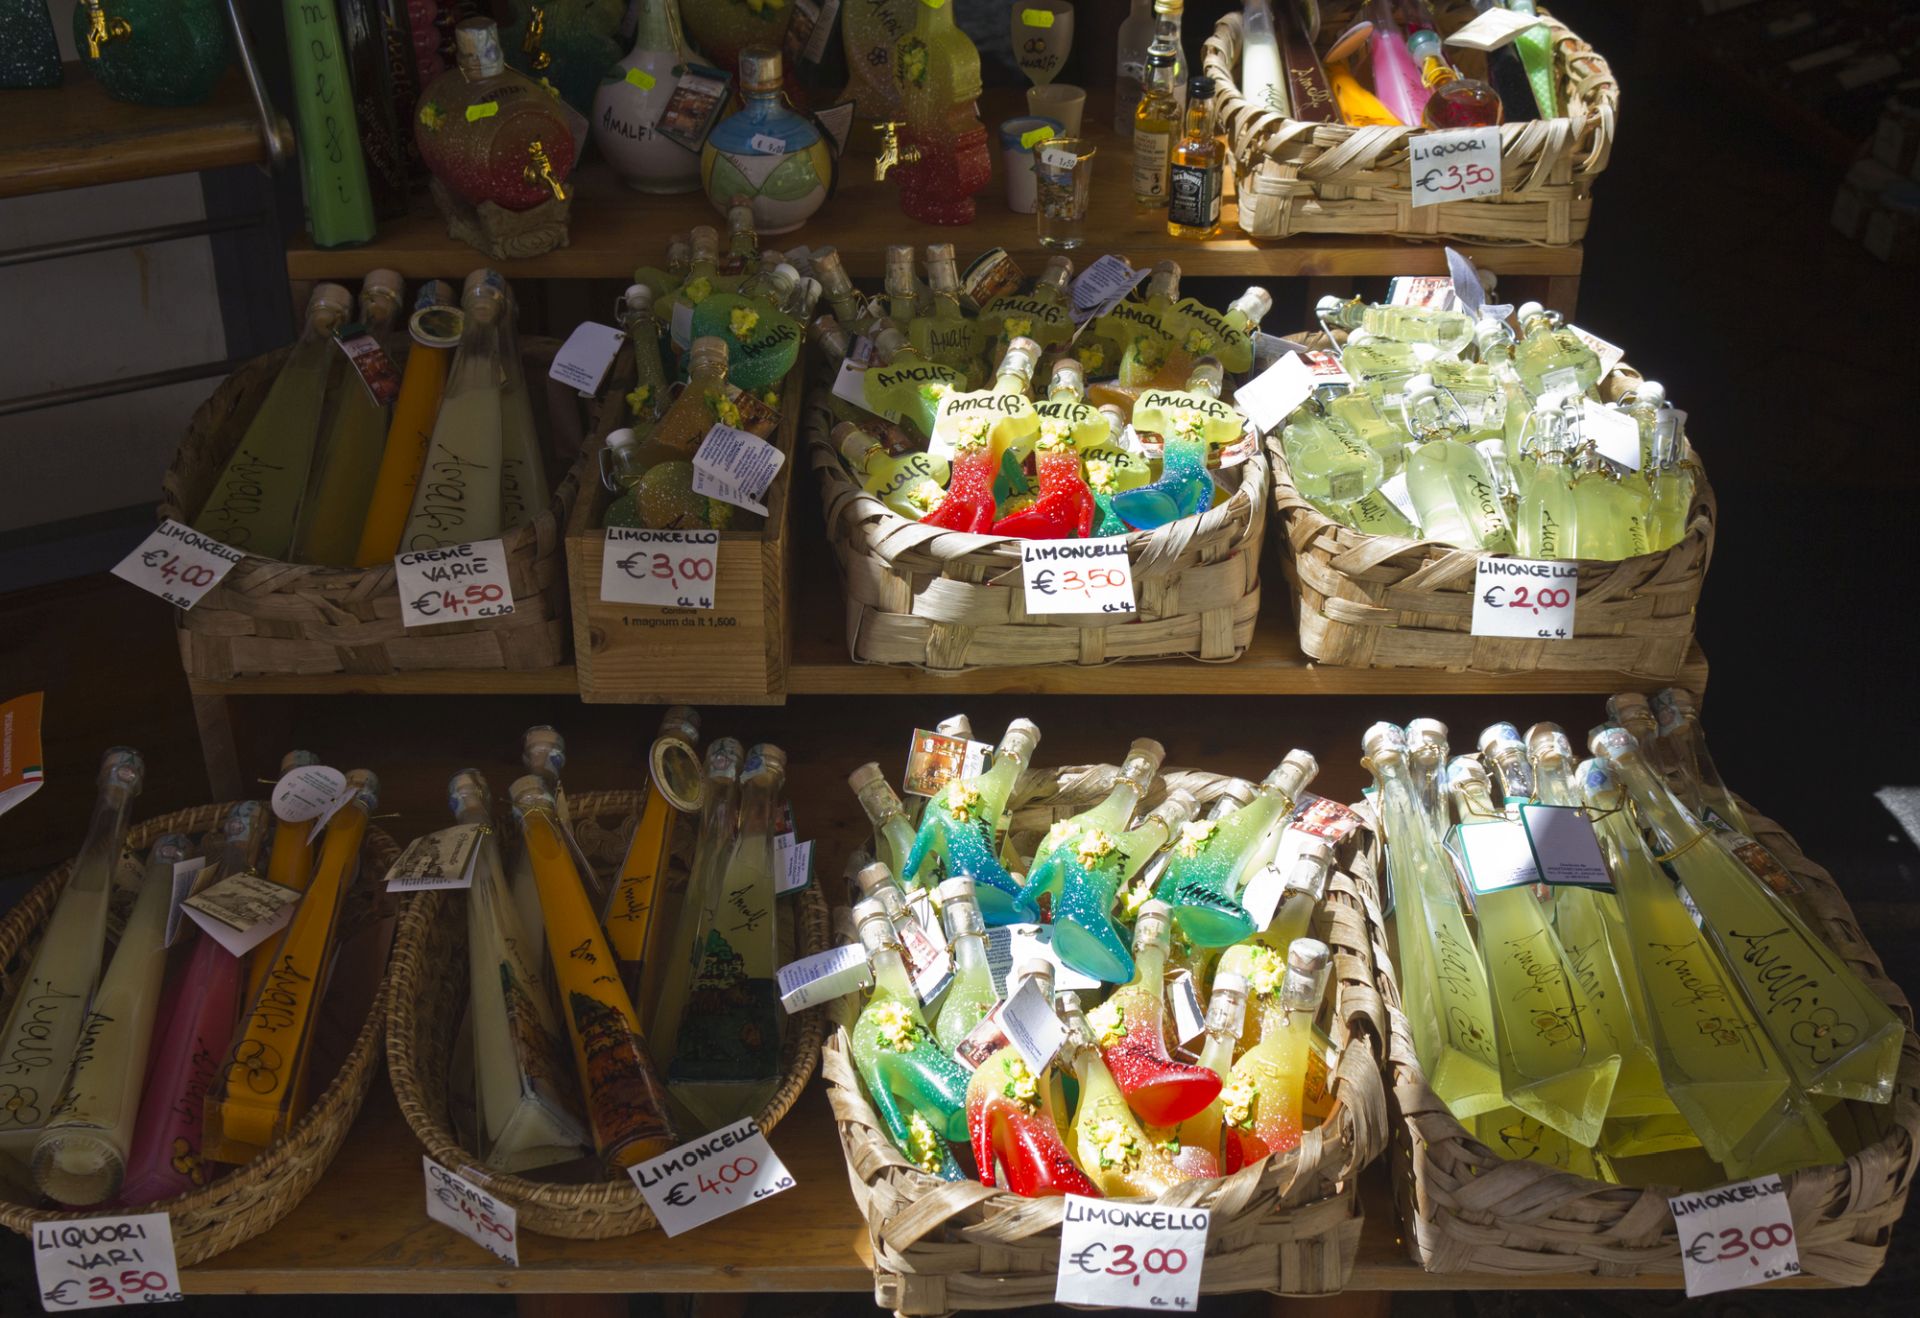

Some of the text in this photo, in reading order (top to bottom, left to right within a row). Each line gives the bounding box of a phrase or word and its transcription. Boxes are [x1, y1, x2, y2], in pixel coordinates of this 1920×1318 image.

[301, 5, 348, 204] malfi
[602, 105, 656, 142] AMALFI
[1414, 139, 1487, 162] LIQUORI
[989, 296, 1066, 323] Amalfi
[1178, 302, 1241, 346] Amalfi
[740, 324, 797, 358] Amalfi
[877, 366, 956, 388] Amalfi
[947, 394, 1026, 416] Amalfi
[1032, 400, 1092, 421] malfi
[1145, 393, 1228, 419] Amalfi
[875, 456, 931, 501] malfi
[156, 521, 243, 563] LIMONCELLO
[607, 529, 717, 545] LIMONCELLO
[401, 545, 475, 567] CREME
[1024, 543, 1129, 563] LIMONCELLO
[422, 558, 489, 583] VARIE
[1478, 560, 1579, 578] LIMONCELLO
[636, 1122, 762, 1188] LIMONCELLO
[429, 1166, 495, 1217] CREME
[1671, 1182, 1785, 1217] LIMONCELLO
[1065, 1201, 1208, 1230] LIMONCELLO
[38, 1223, 146, 1251] LIQUORI
[67, 1248, 144, 1270] VARI
